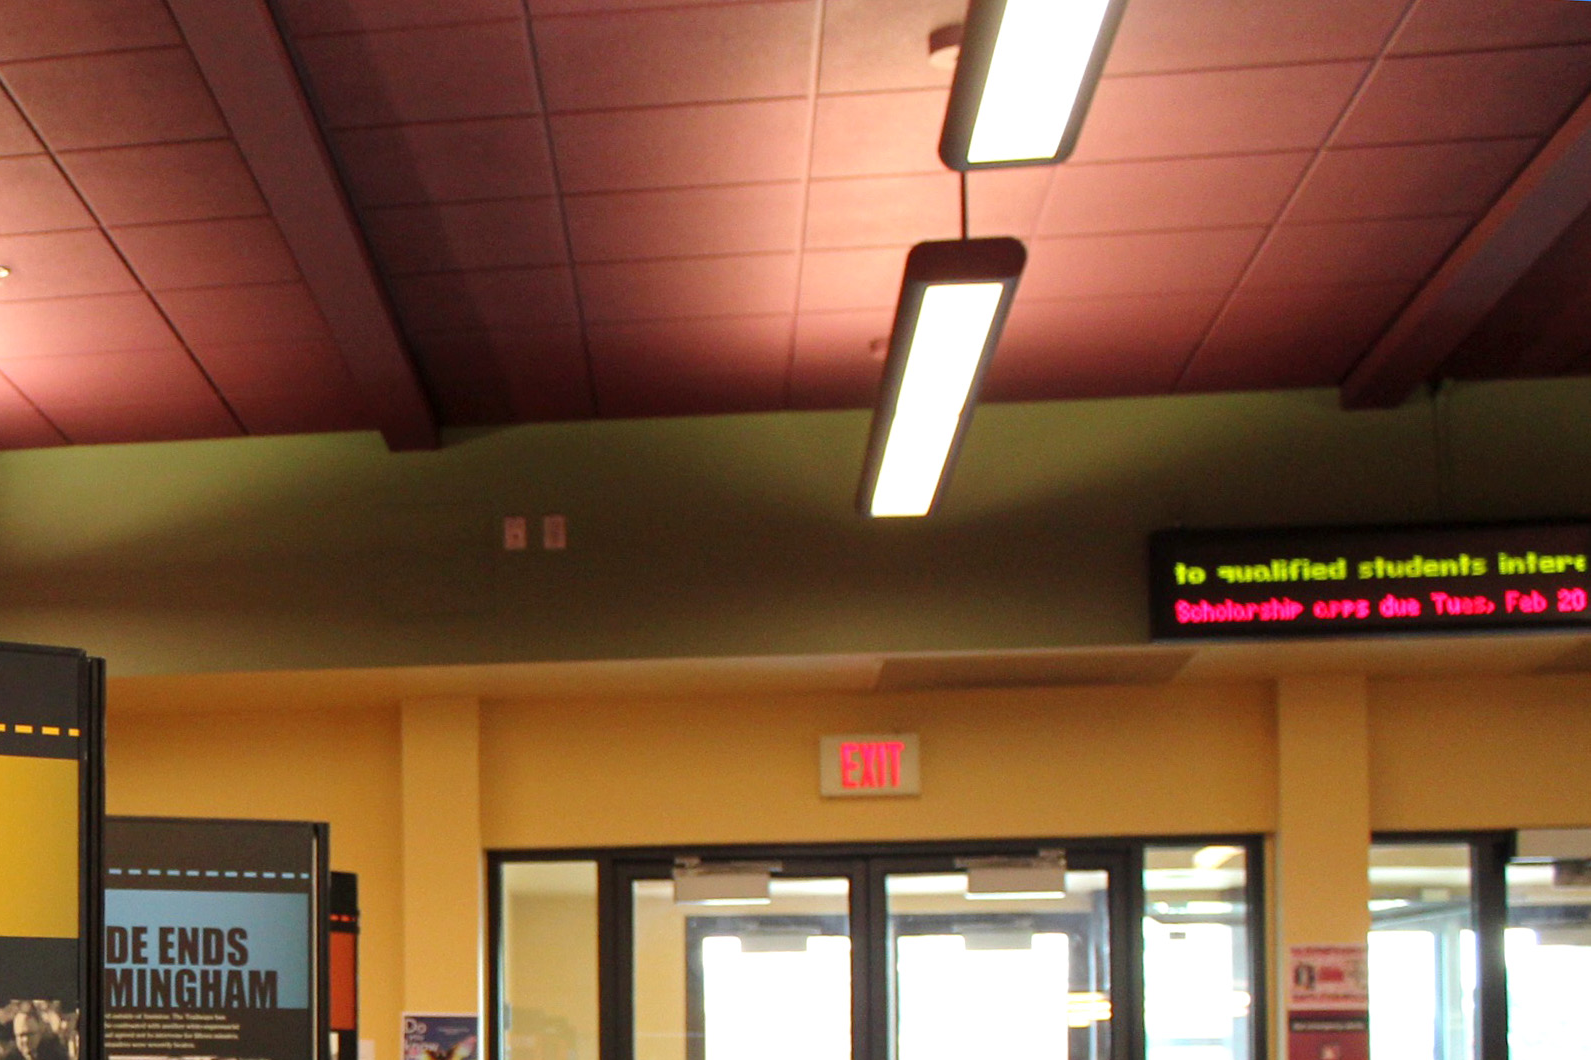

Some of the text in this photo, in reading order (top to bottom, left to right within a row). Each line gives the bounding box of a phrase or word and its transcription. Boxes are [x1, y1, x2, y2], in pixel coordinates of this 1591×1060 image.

[1174, 561, 1207, 585] to
[1216, 557, 1348, 583] qualified
[1357, 553, 1488, 580] students
[1174, 597, 1306, 624] Scholarship
[1379, 594, 1422, 618] due
[1505, 589, 1548, 614] Feb
[840, 741, 906, 788] EXIT
[106, 926, 249, 966] DE ENDS
[104, 968, 277, 1008] MINGHAM
